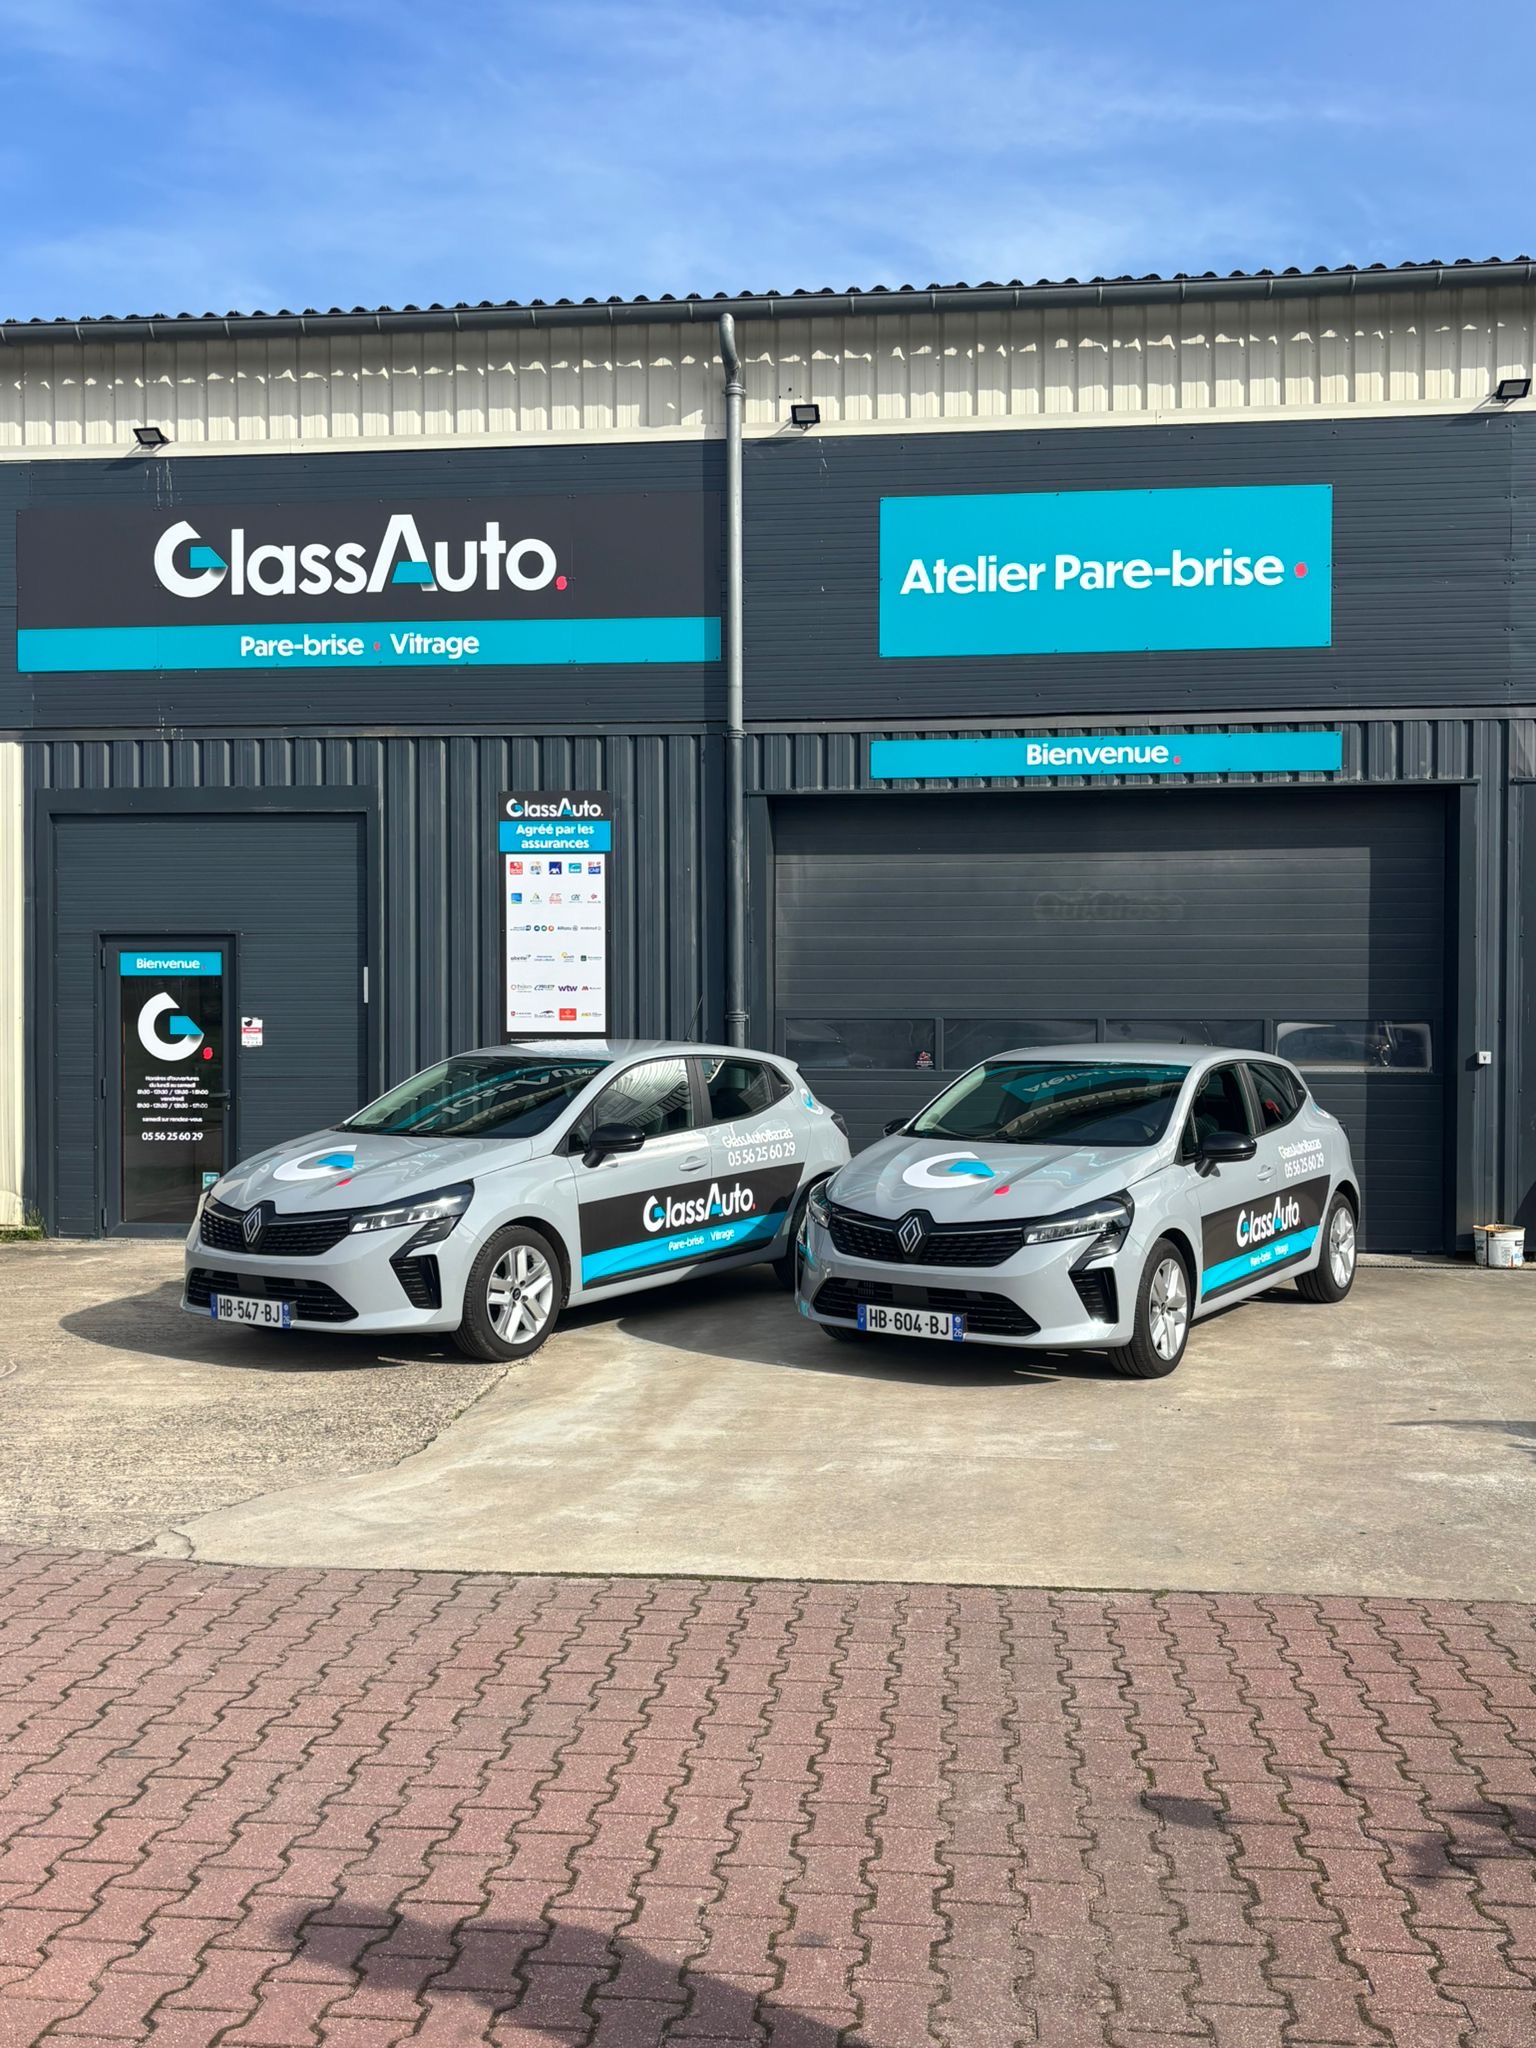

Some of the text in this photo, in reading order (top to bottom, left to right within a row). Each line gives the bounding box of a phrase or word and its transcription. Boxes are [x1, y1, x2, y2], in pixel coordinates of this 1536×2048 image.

[900, 548, 1286, 595] Atelier Pare-brise
[240, 632, 480, 659] Pare-brise Vitrage
[516, 823, 595, 837] Agréé par les
[520, 838, 590, 849] assurances
[141, 1132, 204, 1141] 05 56 25 60 29
[728, 1141, 796, 1167] 05 56 25 60 29
[1284, 1152, 1324, 1178] 05 56 25 60 29
[668, 1228, 735, 1251] Pare-brise Vitrage
[219, 1297, 280, 1324] HB-547-BJ
[869, 1308, 949, 1335] HB-604-BJ
[953, 1327, 963, 1338] 26
